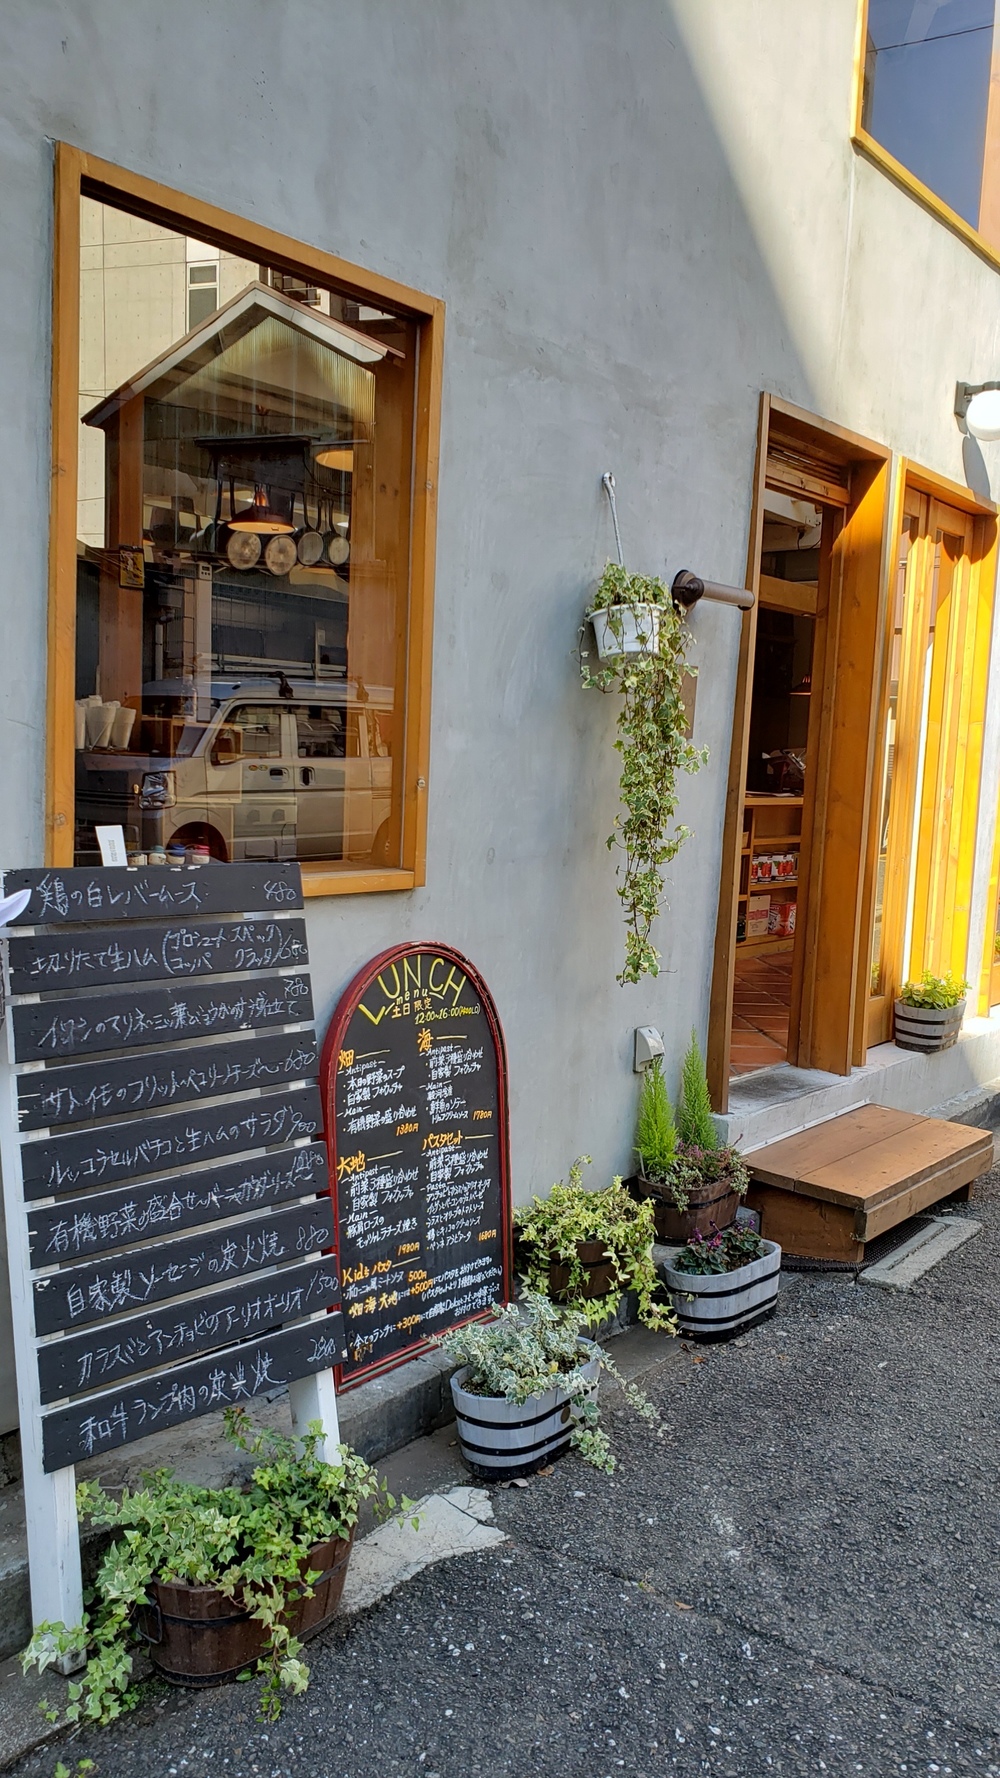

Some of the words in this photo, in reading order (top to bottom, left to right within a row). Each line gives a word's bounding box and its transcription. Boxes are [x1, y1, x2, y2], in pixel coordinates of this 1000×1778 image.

[263, 880, 297, 901] 480
[358, 954, 467, 1026] LUNCH
[396, 987, 429, 1005] menu
[417, 1027, 434, 1053] 海
[338, 1049, 355, 1070] 畑
[336, 1150, 366, 1180] 大地
[297, 1225, 329, 1250] 880
[341, 1262, 370, 1288] Kids
[408, 1269, 428, 1282] 500円
